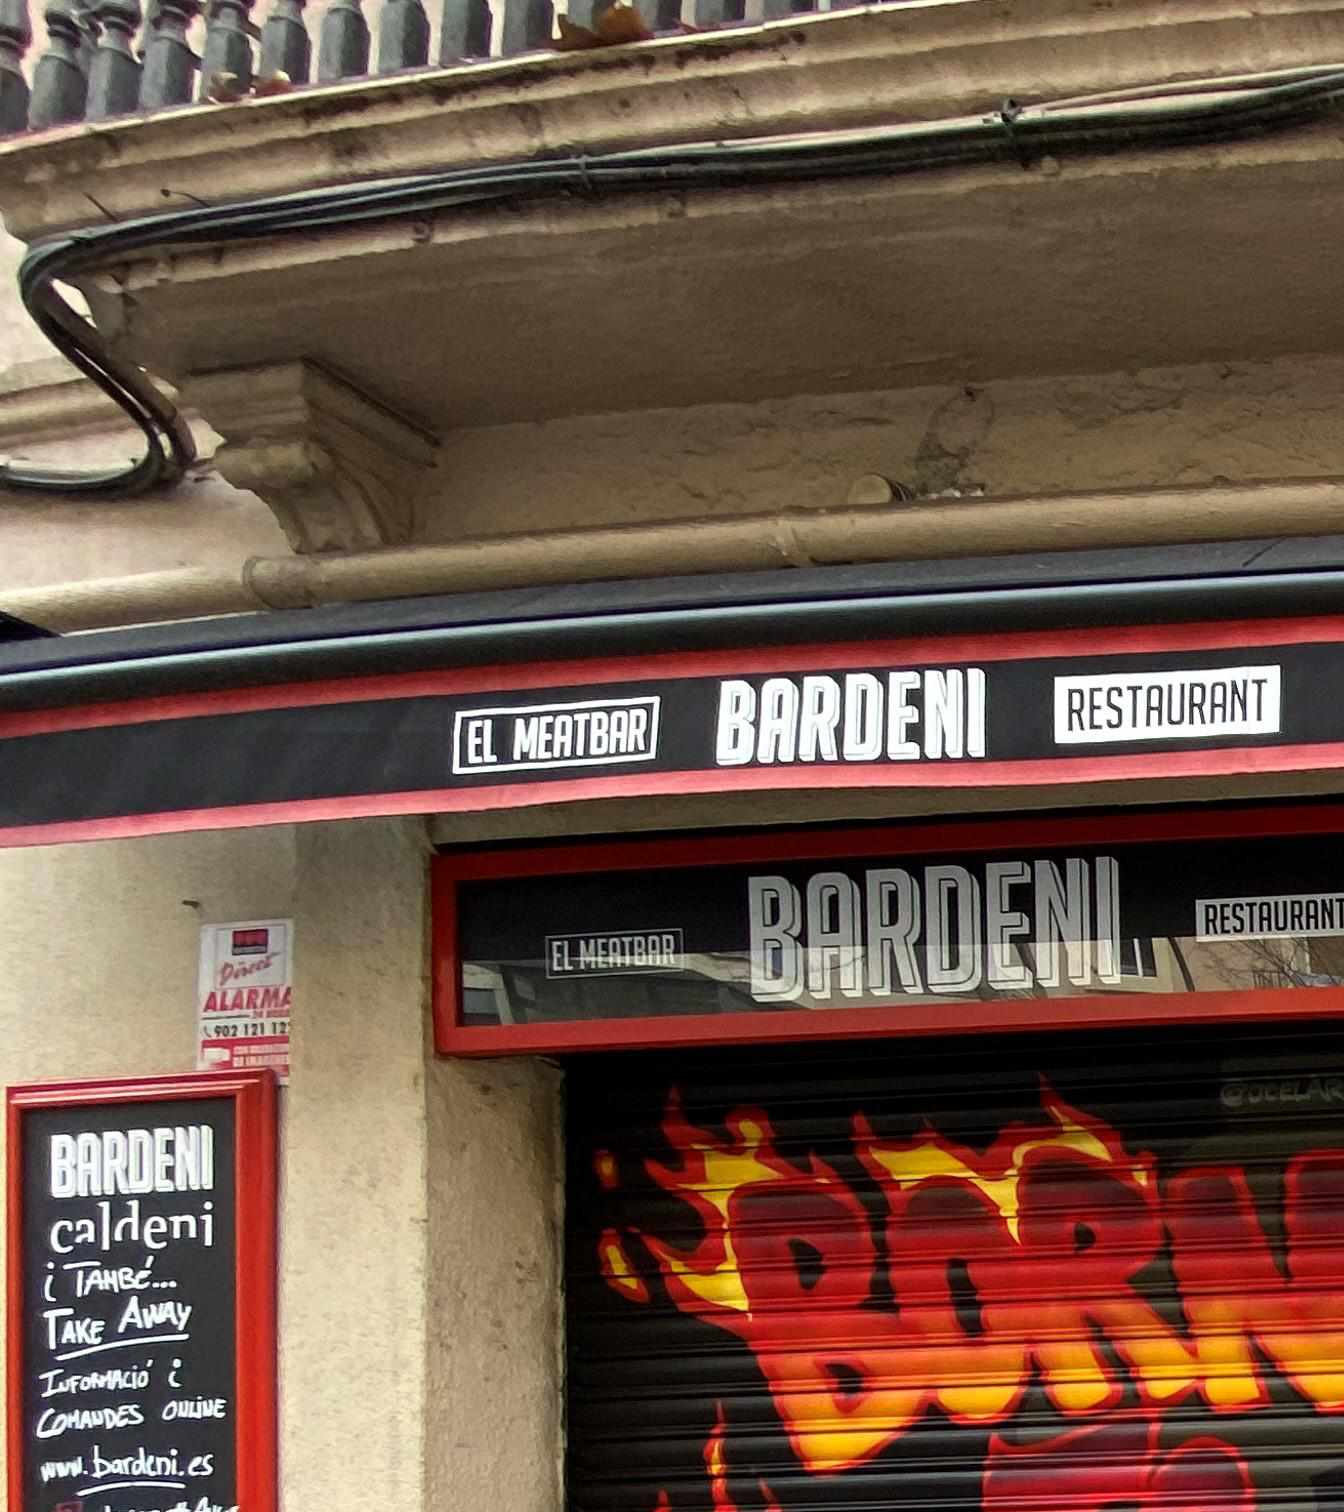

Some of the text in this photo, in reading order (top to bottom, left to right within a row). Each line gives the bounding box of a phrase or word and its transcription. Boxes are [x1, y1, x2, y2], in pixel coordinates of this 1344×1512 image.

[715, 667, 987, 766] BARDENI
[1067, 678, 1268, 731] RESTAURANT
[468, 707, 648, 764] EL MEATBAR
[552, 933, 676, 973] EL MEATBAR
[748, 855, 1122, 1003] BARDENI
[203, 986, 292, 1012] ALARMA
[214, 1024, 238, 1037] 902
[50, 1125, 214, 1198] BARDENI
[50, 1200, 214, 1254] caldeni
[43, 1296, 192, 1350] TAKE AWAY
[40, 1445, 214, 1482] www.bardeni.es
